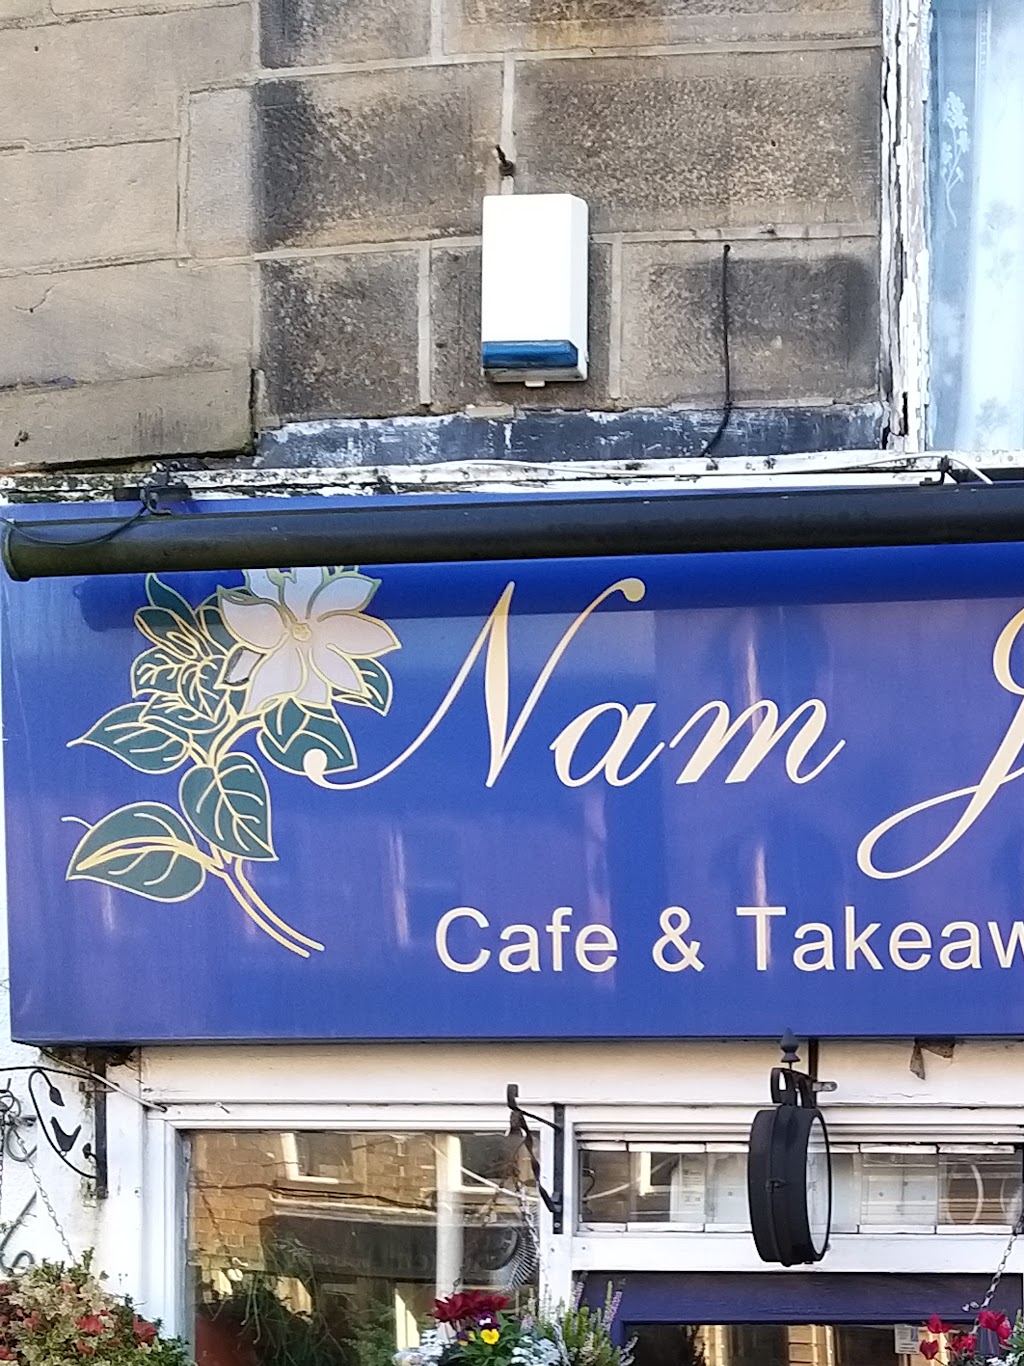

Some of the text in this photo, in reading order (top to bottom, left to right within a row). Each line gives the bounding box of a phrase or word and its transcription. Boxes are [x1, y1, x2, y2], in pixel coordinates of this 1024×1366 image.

[304, 577, 846, 790] Nam
[436, 905, 618, 972] Cafe
[653, 905, 705, 972] &
